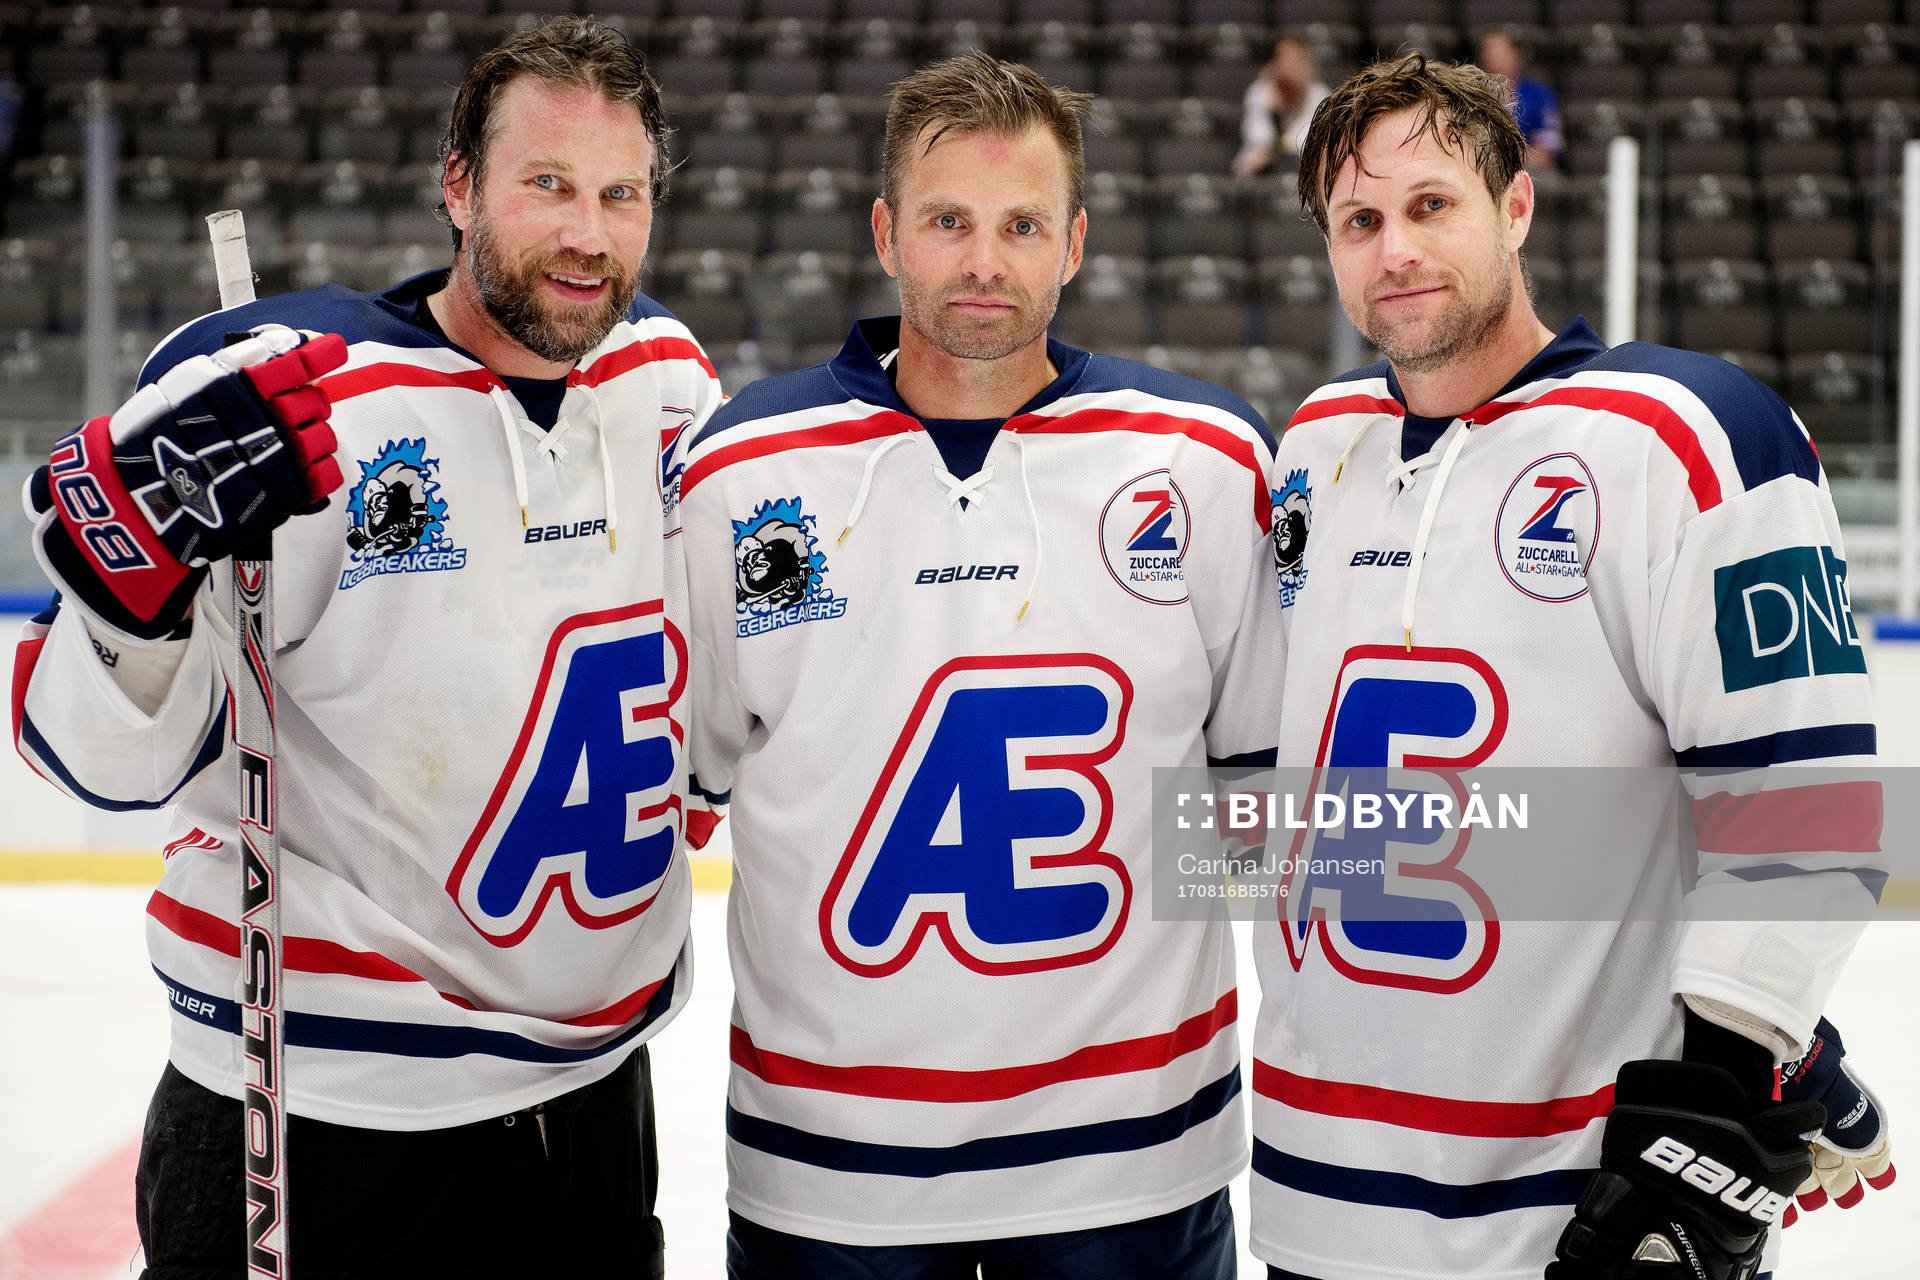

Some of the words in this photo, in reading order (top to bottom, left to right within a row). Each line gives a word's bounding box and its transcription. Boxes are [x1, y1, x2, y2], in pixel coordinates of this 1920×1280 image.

[339, 548, 468, 590] ICEBREAKERS
[1129, 557, 1182, 570] ZUCCARE
[1517, 546, 1580, 564] ZUCCARELL
[736, 598, 848, 638] CEBREAERS
[168, 985, 216, 1019] AUER
[236, 744, 284, 1280] EASTON
[1639, 1136, 1794, 1223] BAUE
[1670, 1222, 1708, 1280] SUPREM
